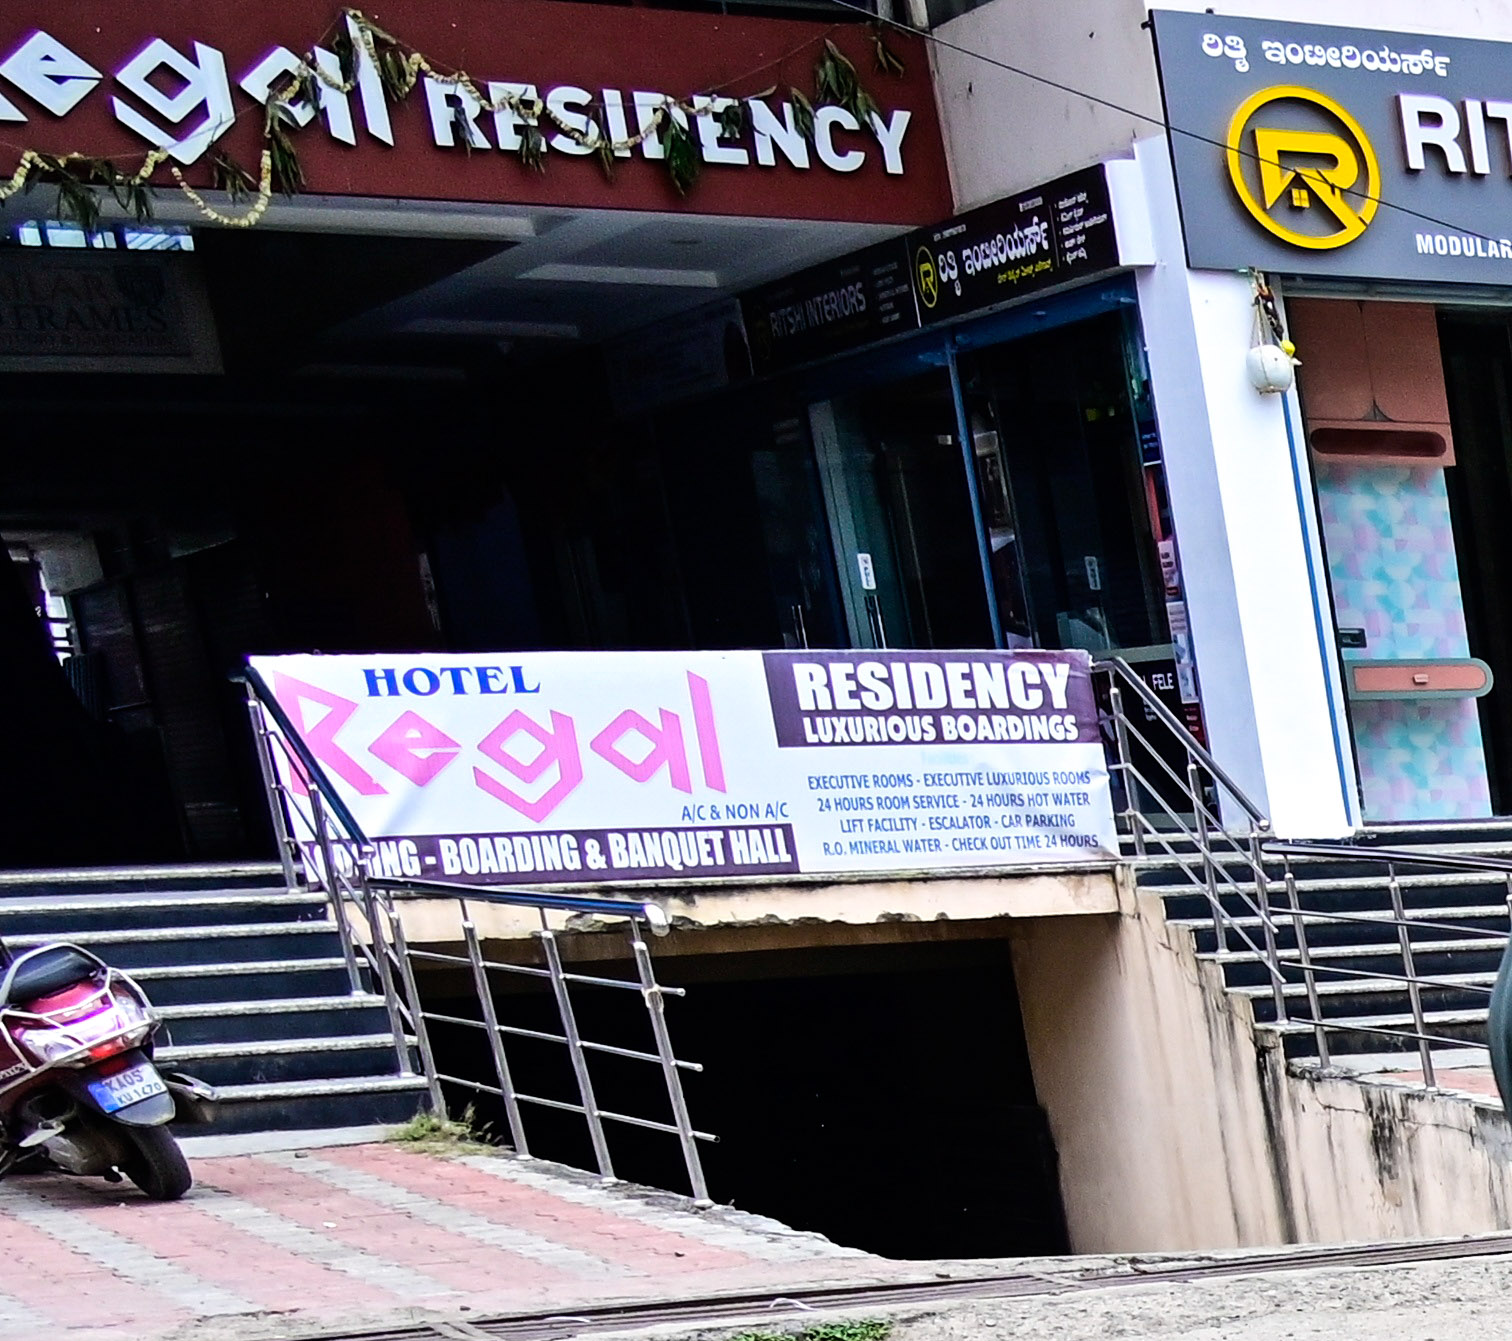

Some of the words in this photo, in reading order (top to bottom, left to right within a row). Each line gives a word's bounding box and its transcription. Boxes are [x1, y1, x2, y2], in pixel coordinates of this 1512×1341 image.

[0, 8, 394, 166] egal
[425, 77, 914, 175] RESIDENCY
[1416, 234, 1512, 259] MODULAR
[361, 665, 542, 697] HOTEL
[792, 661, 1071, 712] RESIDENCY
[802, 715, 938, 743] LUXURIOUS
[941, 713, 1079, 742] BOARDINGS
[272, 669, 727, 823] Regal
[808, 775, 872, 790] EXECUTIVE
[873, 773, 914, 789] ROOMS
[924, 772, 983, 788] EXECUTIVE
[986, 771, 1050, 786] LUXURIOUS
[1052, 770, 1091, 785] ROOMS
[681, 802, 708, 822] A/C
[726, 802, 761, 821] NON
[764, 800, 790, 820] A/C
[833, 797, 873, 812] HOURS
[875, 796, 911, 811] ROOM
[913, 795, 960, 810] SERVICE
[986, 793, 1026, 808] HOURS
[1027, 792, 1050, 807] HOT
[1052, 791, 1090, 806] WATER
[840, 818, 864, 833] LIFT
[867, 816, 918, 832] FACILITY
[929, 815, 993, 831] ESCALATOR
[1001, 814, 1023, 829] CAR
[1024, 813, 1076, 829] PARKING
[441, 838, 582, 876] BOARDING
[607, 830, 726, 871] BANQUET
[730, 826, 791, 864] HALL
[849, 839, 901, 856] MINERAL
[903, 838, 942, 853] WATER
[952, 837, 989, 851] CHECK
[990, 836, 1014, 850] OUT
[1015, 835, 1042, 849] TIME
[1059, 834, 1099, 849] HOURS
